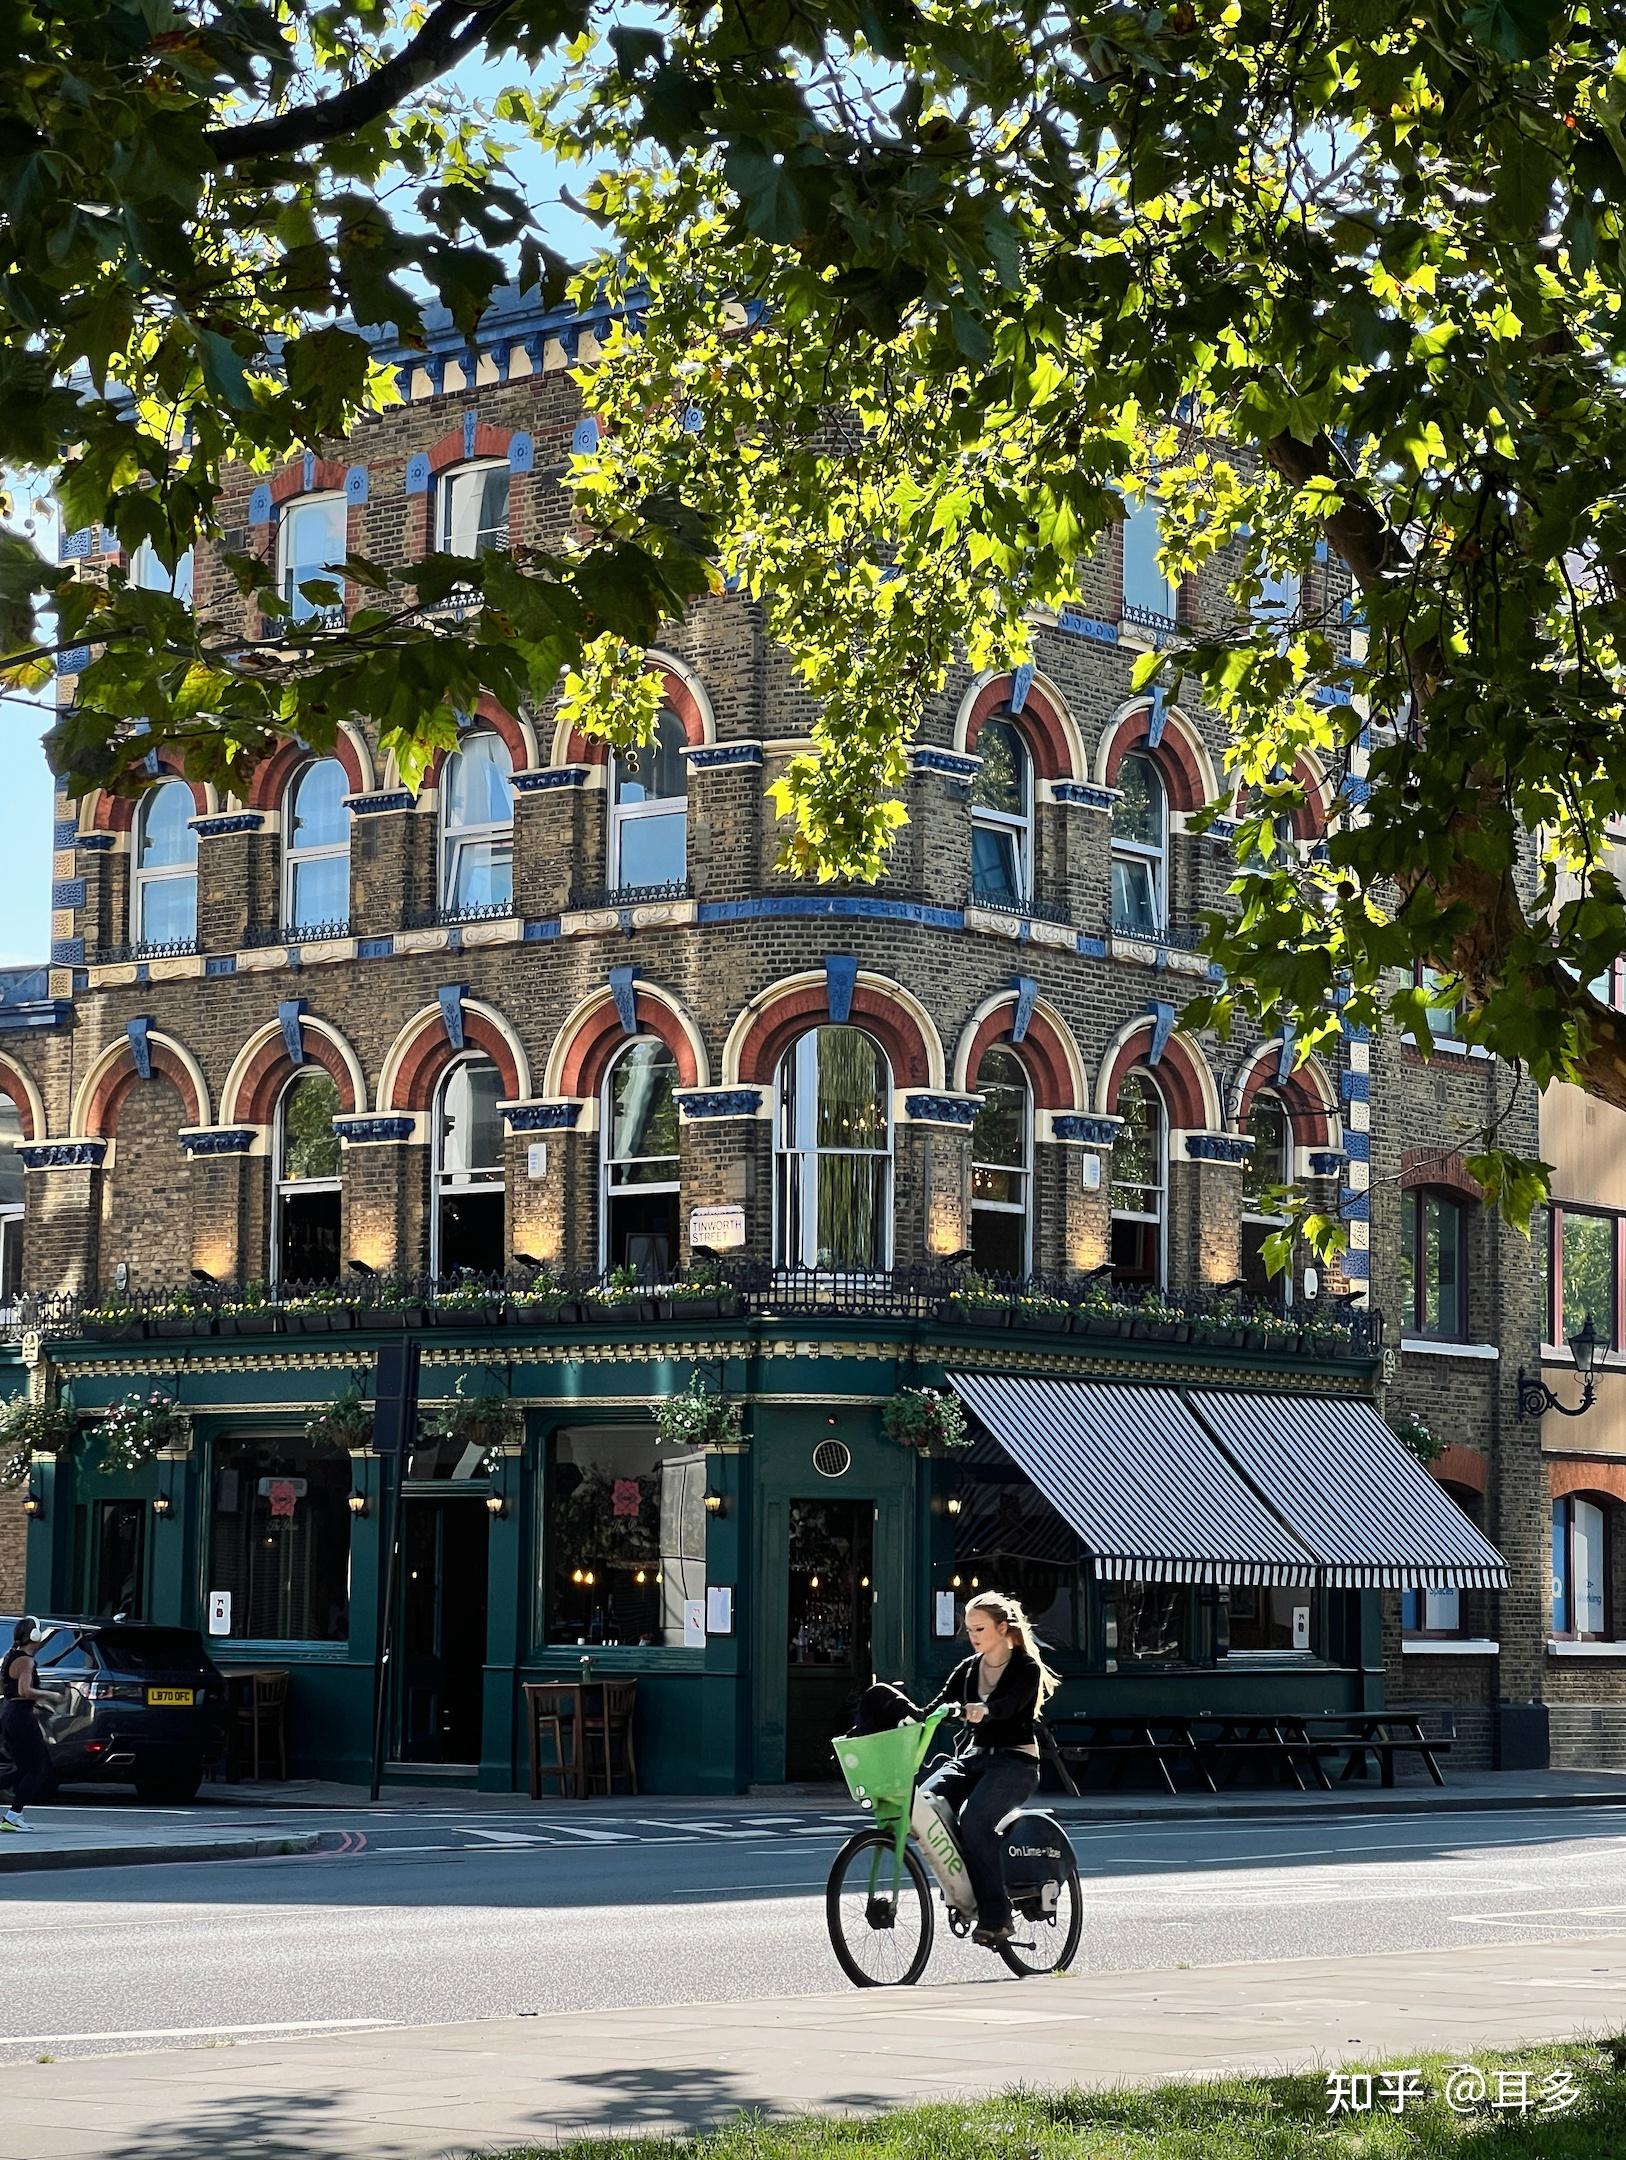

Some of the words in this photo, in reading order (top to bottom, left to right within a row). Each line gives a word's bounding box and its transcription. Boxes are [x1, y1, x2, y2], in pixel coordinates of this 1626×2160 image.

[692, 1219, 742, 1232] TINWORTH
[692, 1231, 728, 1244] STREET
[151, 1691, 173, 1701] LB70
[927, 1819, 963, 1876] Lime
[1008, 1845, 1022, 1857] On
[1022, 1845, 1042, 1857] Lime
